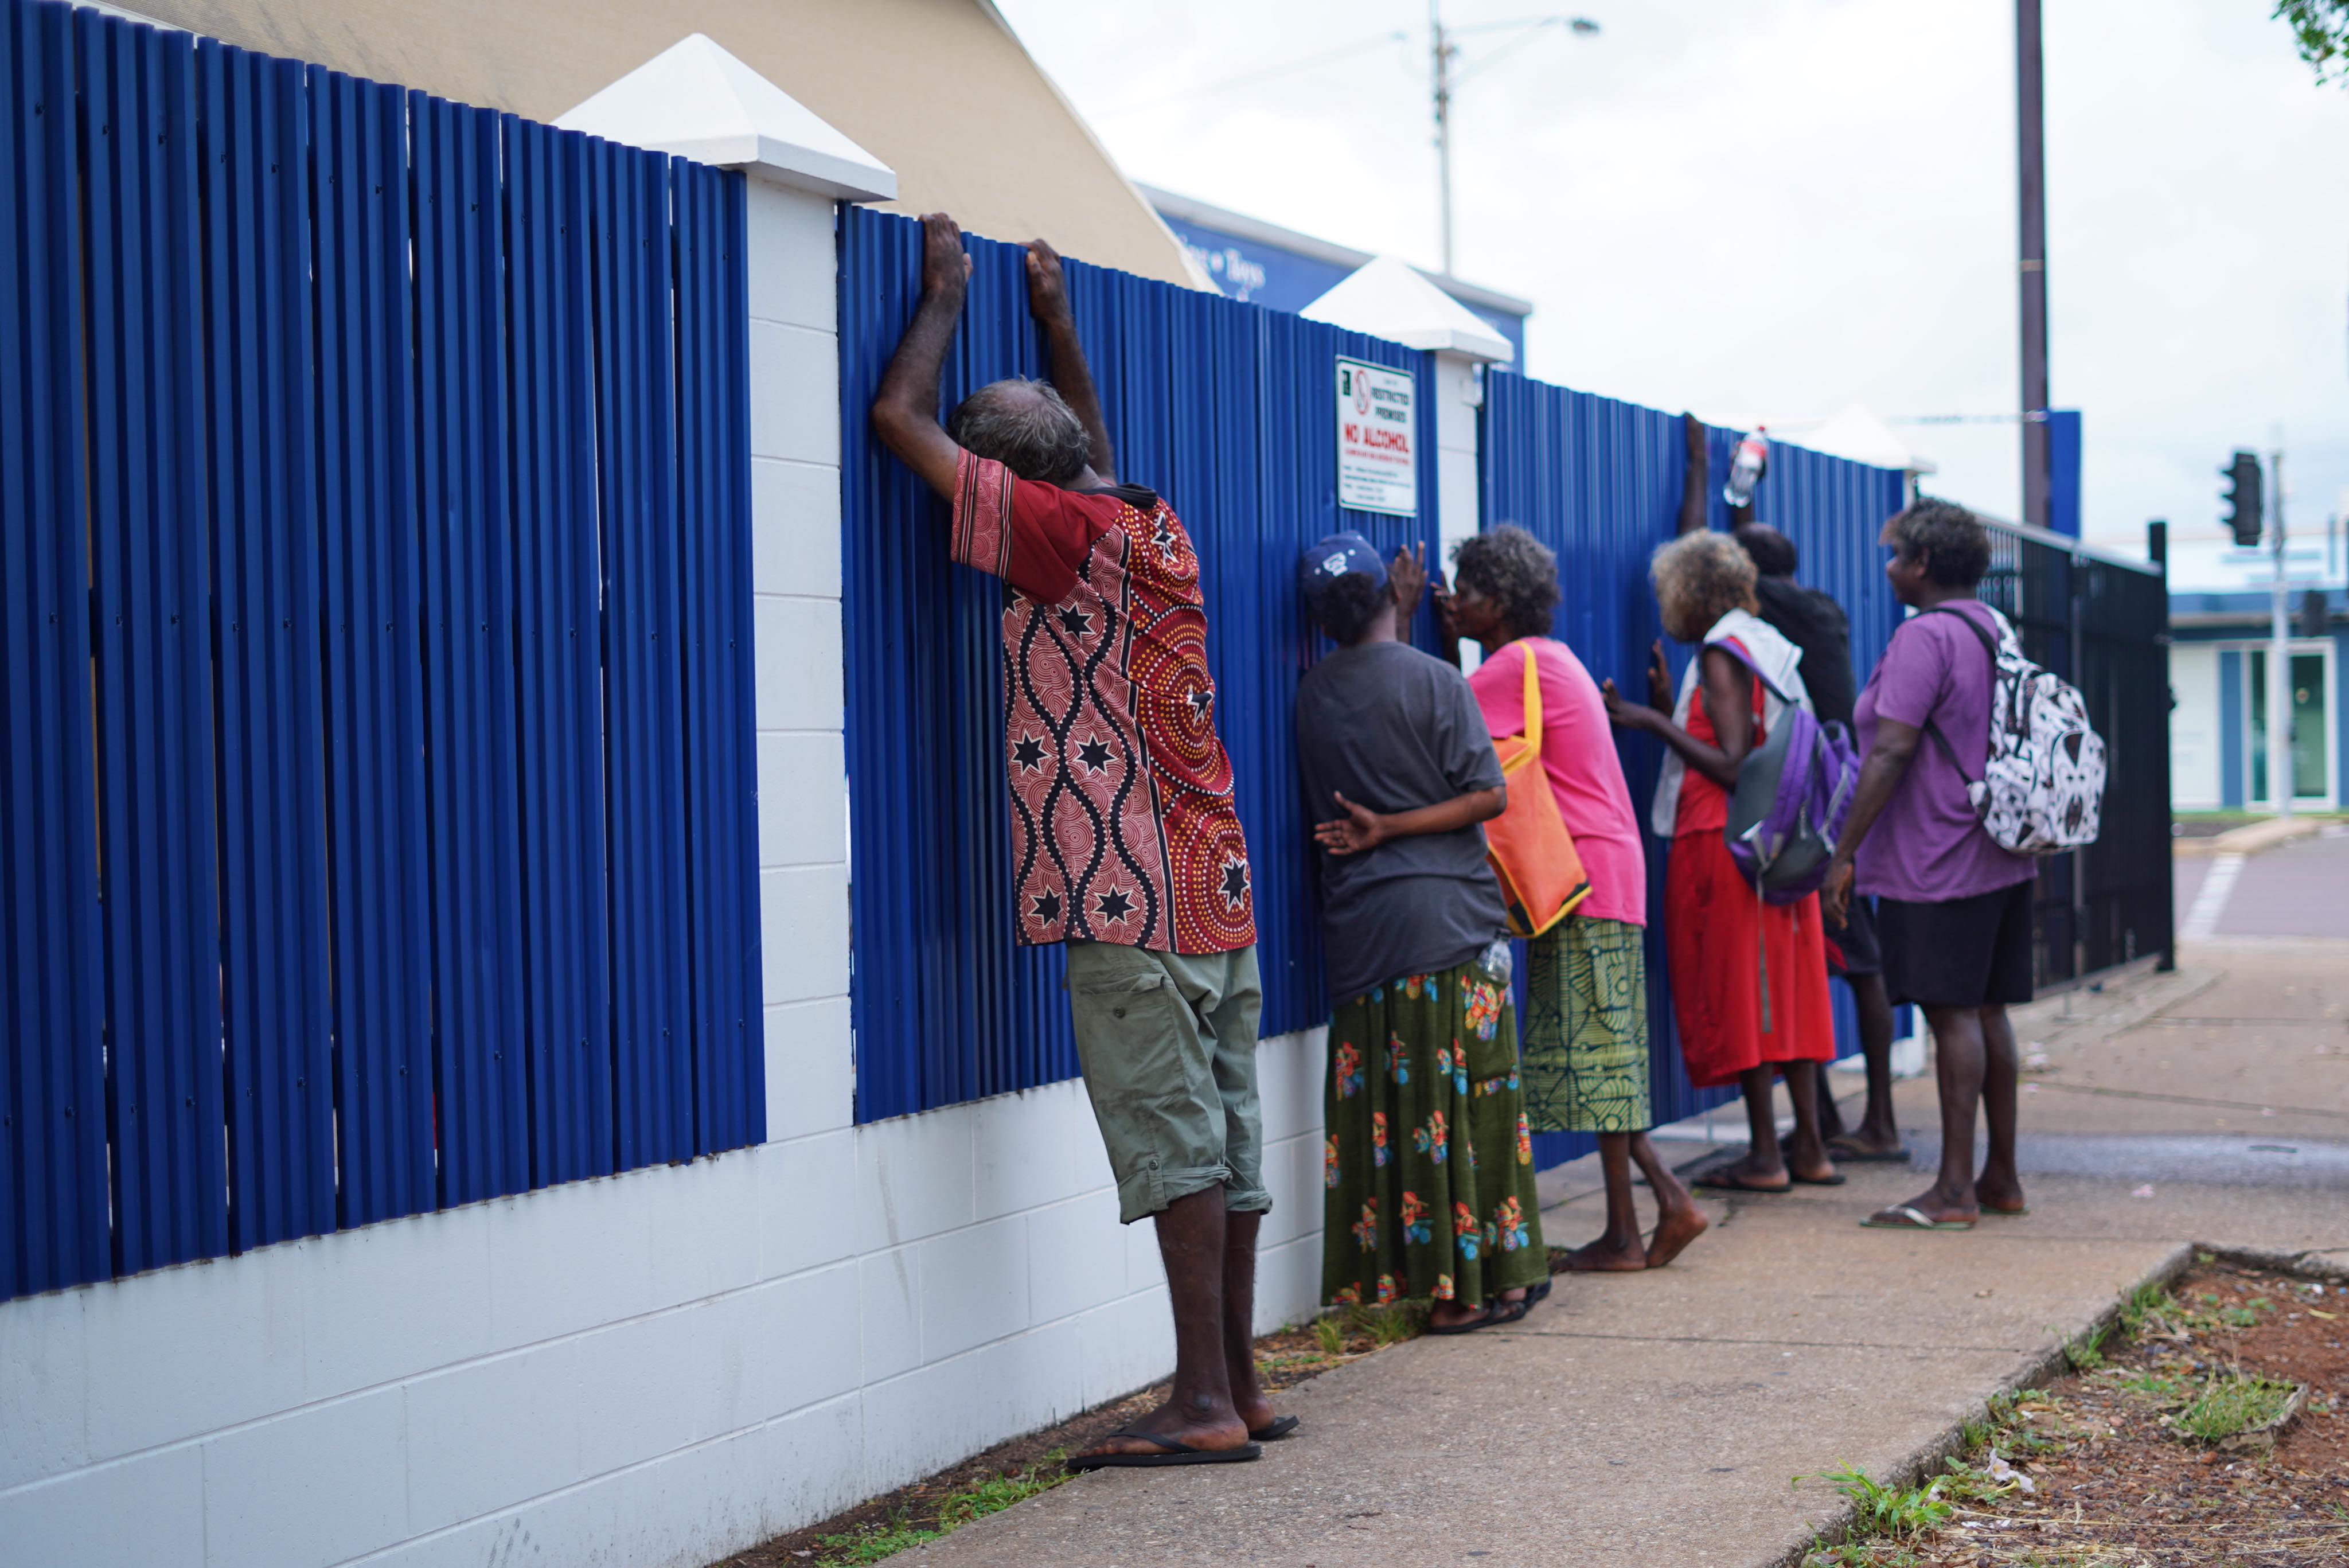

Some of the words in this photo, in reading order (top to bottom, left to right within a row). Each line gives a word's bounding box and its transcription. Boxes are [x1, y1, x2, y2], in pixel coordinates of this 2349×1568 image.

[1371, 386, 1410, 405] RESTRICTED
[1375, 405, 1406, 423] PREMISES
[1344, 422, 1359, 444] NO
[1363, 426, 1410, 454] ALCOHOL
